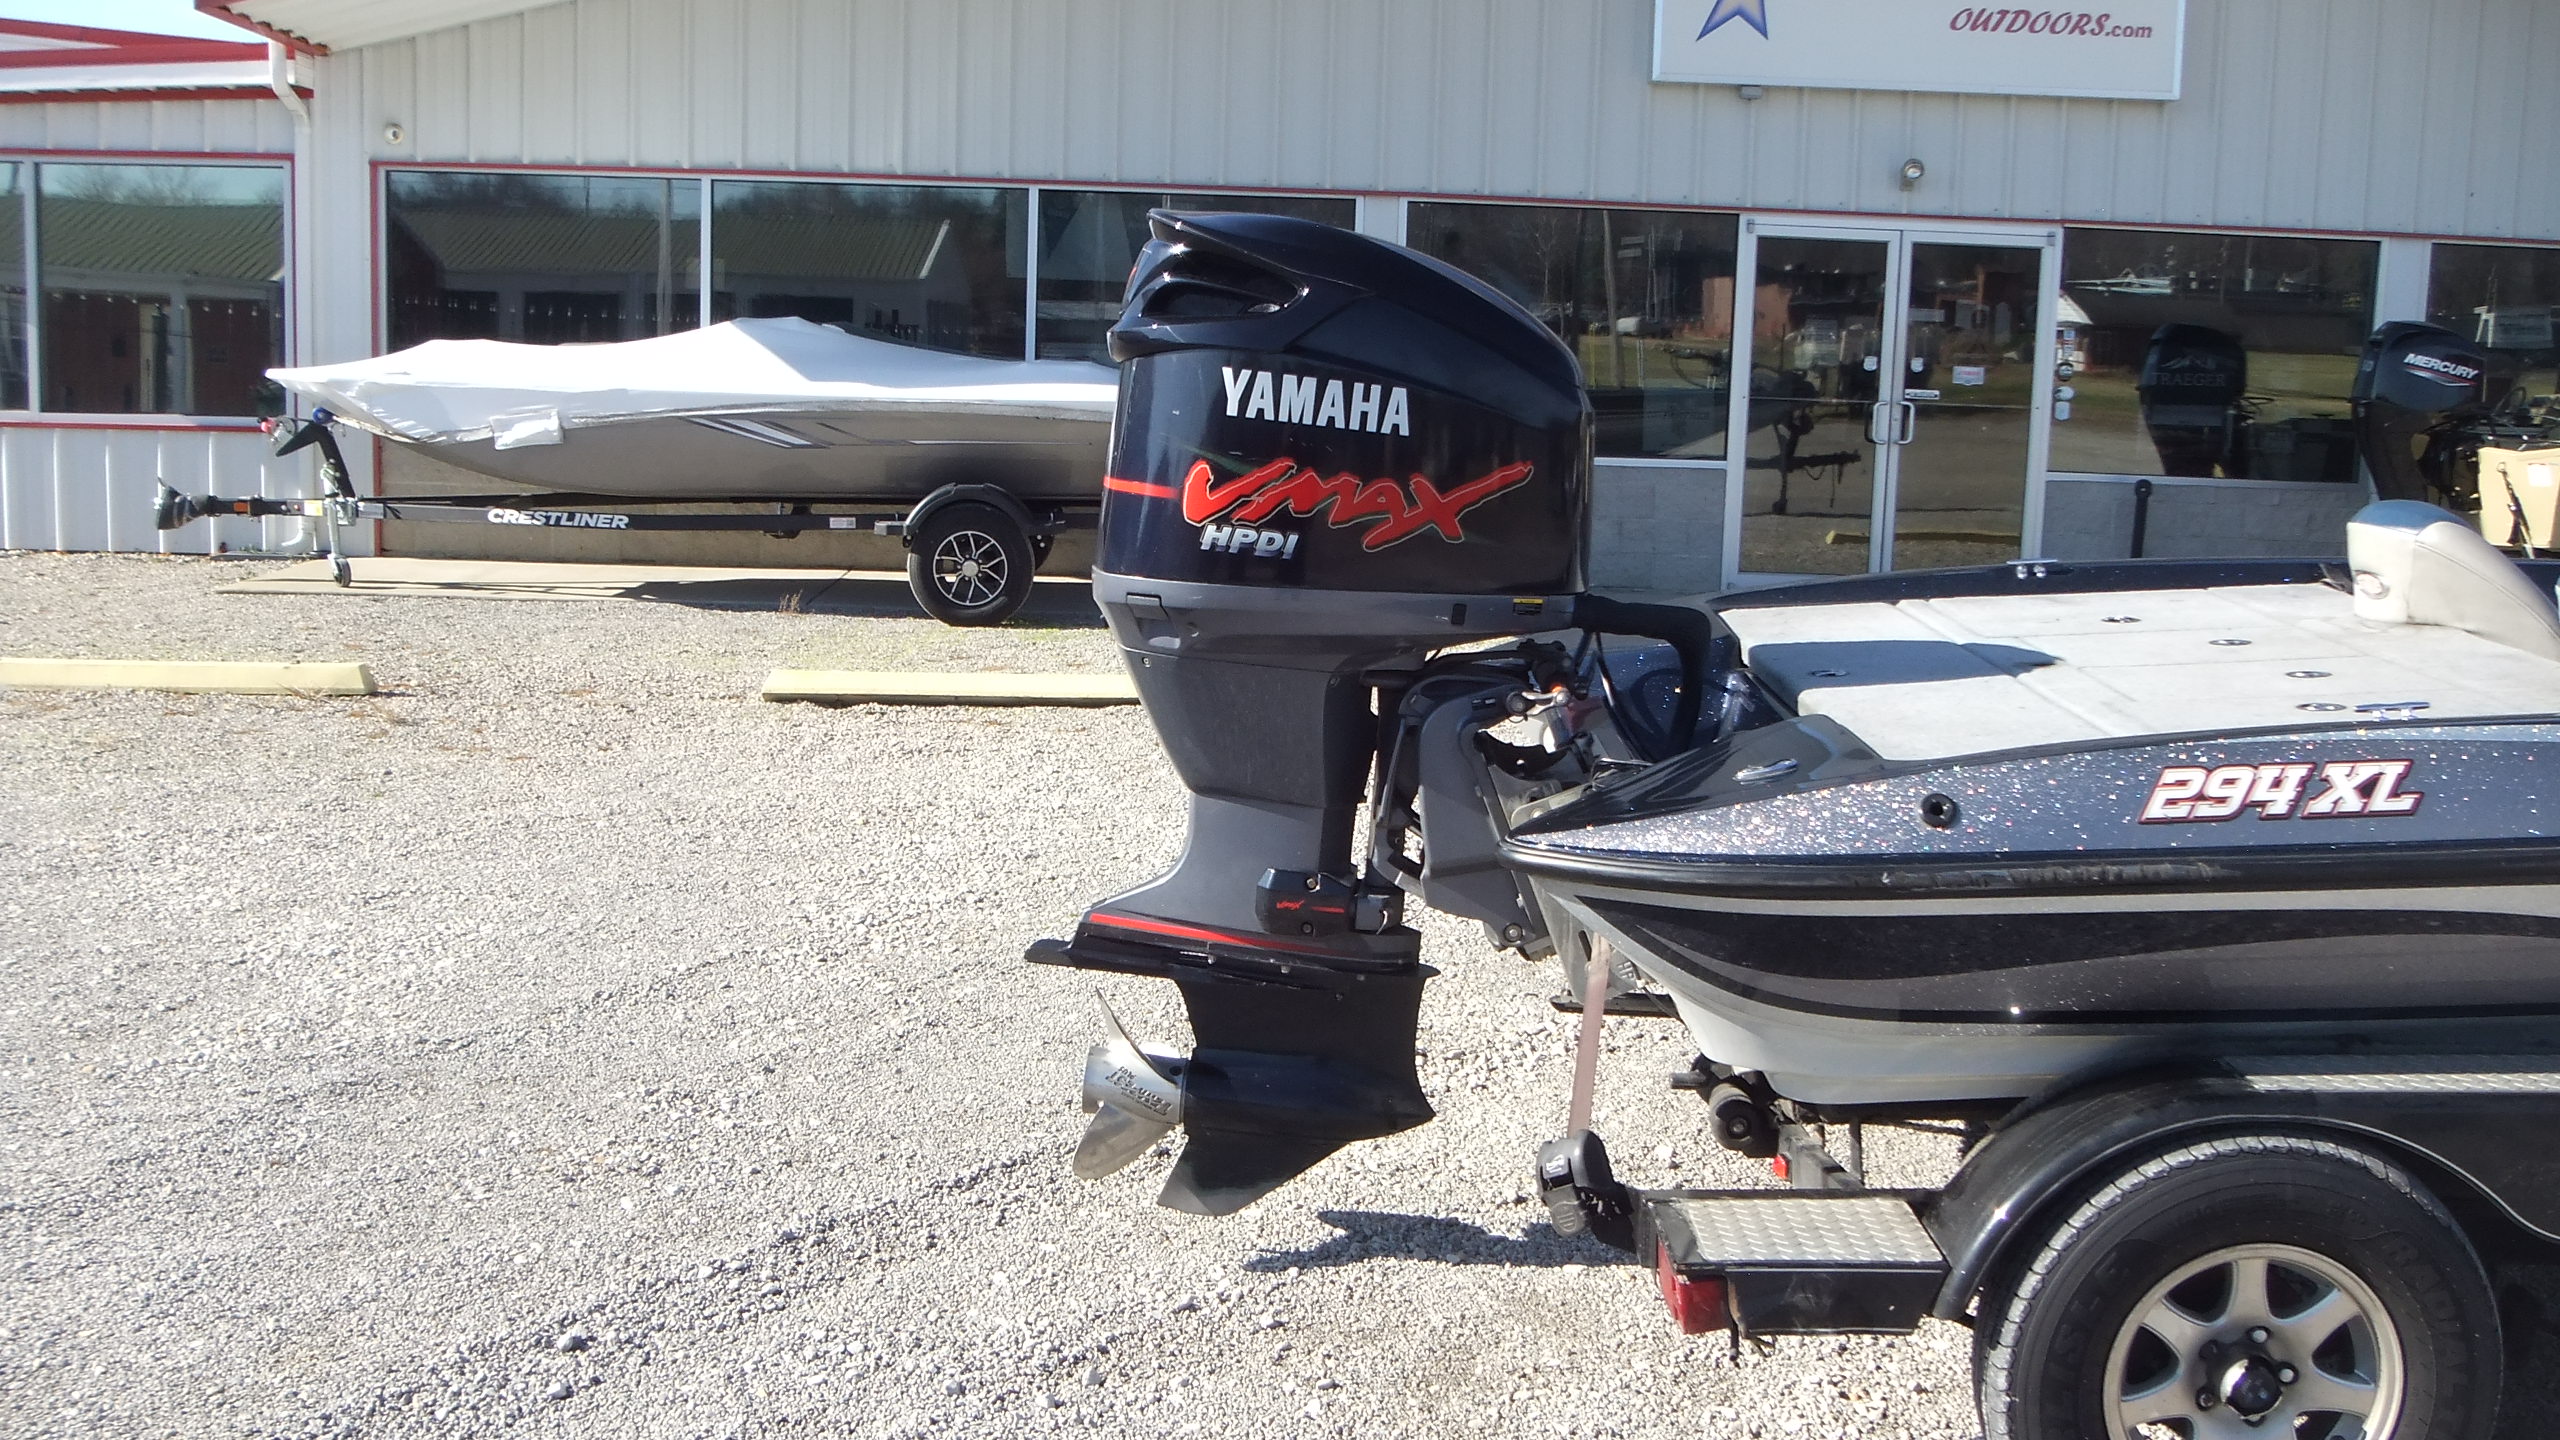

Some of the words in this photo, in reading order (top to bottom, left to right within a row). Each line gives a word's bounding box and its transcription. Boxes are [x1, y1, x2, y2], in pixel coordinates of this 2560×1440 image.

[1949, 8, 2153, 38] OUTDOORS.com
[2403, 352, 2480, 379] MERCURY
[1221, 366, 1410, 437] YAMAHA
[487, 508, 630, 529] CRESTLINER
[1200, 523, 1300, 560] HPDI
[2137, 761, 2317, 825] 294
[2299, 758, 2425, 820] XL
